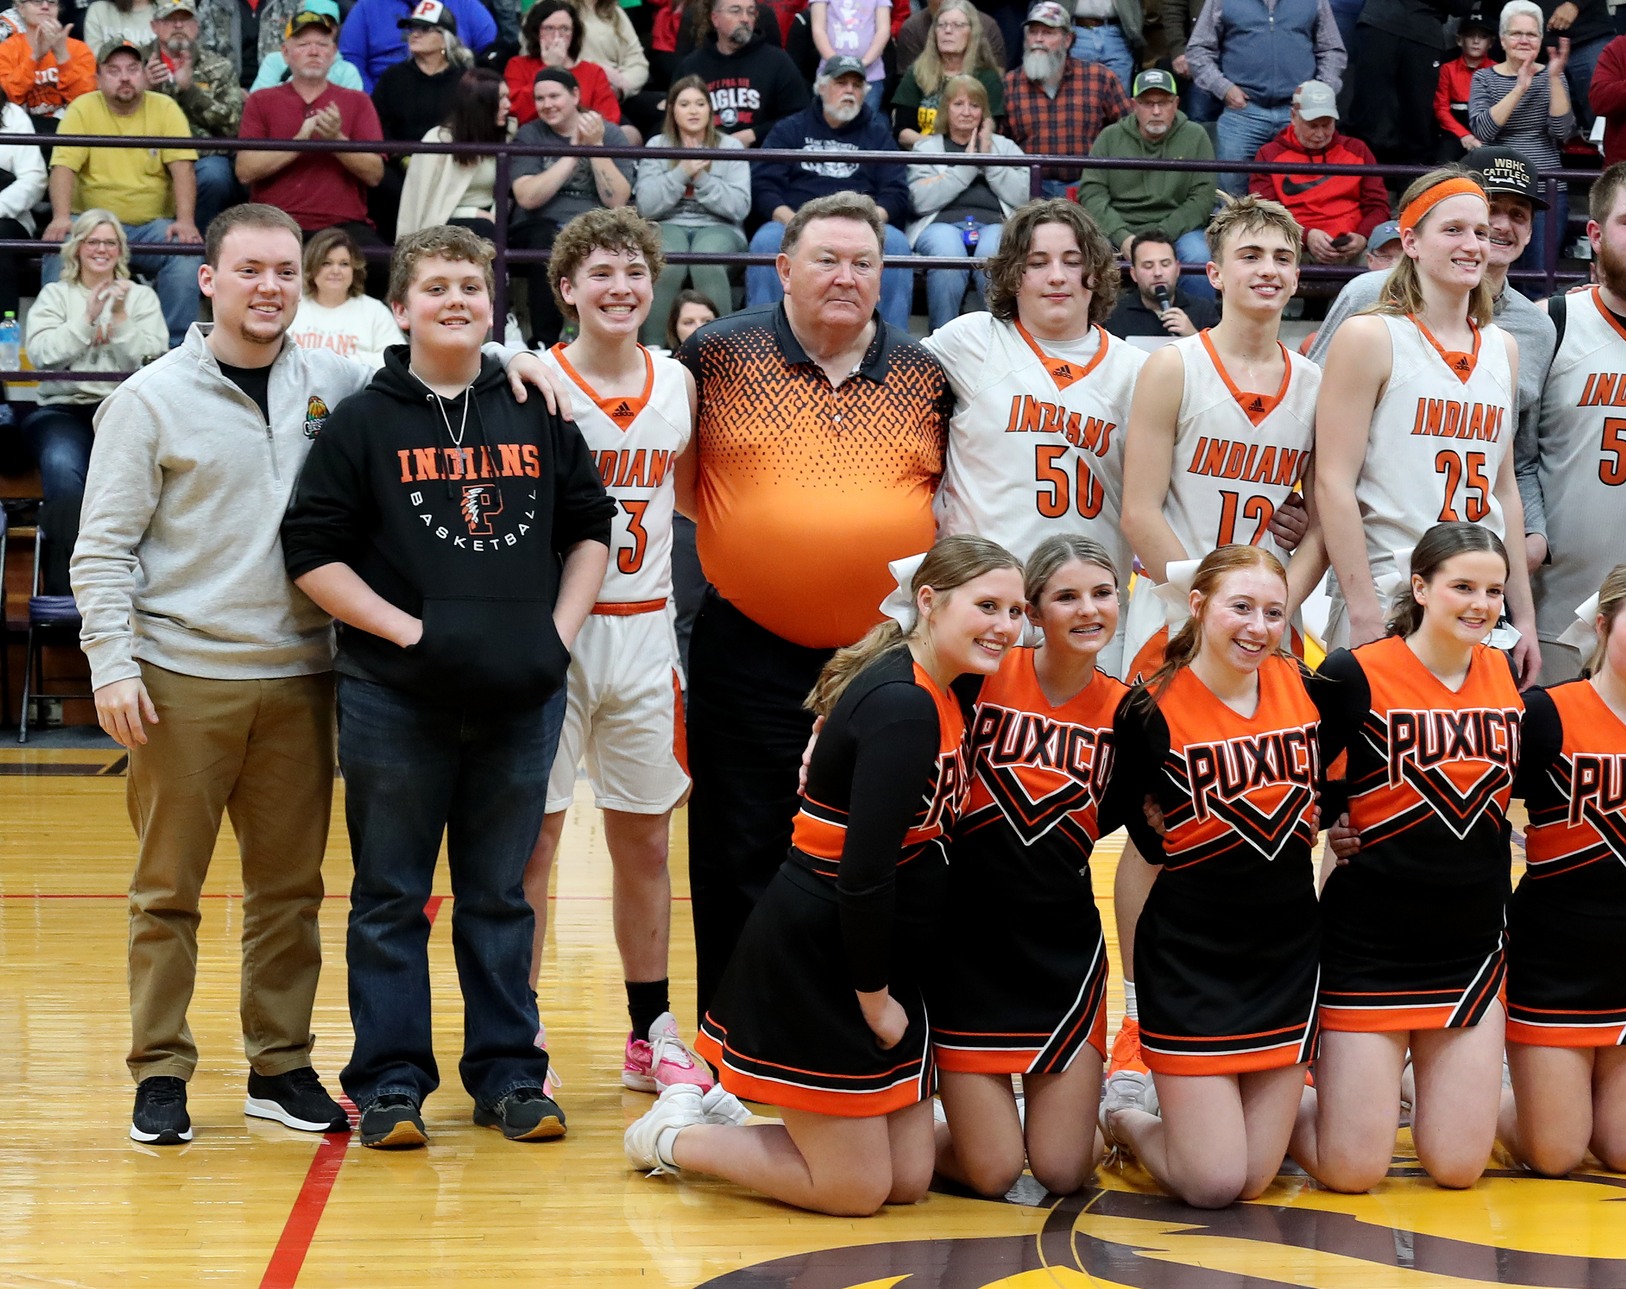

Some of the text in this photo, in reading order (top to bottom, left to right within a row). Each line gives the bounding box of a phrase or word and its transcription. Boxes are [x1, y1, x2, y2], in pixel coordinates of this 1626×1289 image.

[418, 2, 435, 15] P
[709, 87, 761, 111] GLES
[1483, 168, 1521, 180] CATTLE
[1494, 158, 1525, 172] WBHC
[293, 331, 359, 355] NDIANS
[1005, 394, 1117, 457] INDIANS
[398, 443, 541, 483] INDIANS
[590, 449, 676, 487] DIAN
[1035, 444, 1104, 519] 50
[1435, 449, 1490, 523] 25
[410, 489, 537, 551] BASKETBALL
[617, 499, 650, 575] 3
[1216, 489, 1275, 548] 12
[968, 702, 1115, 807] PUXICO
[1386, 707, 1521, 790] PUXICO
